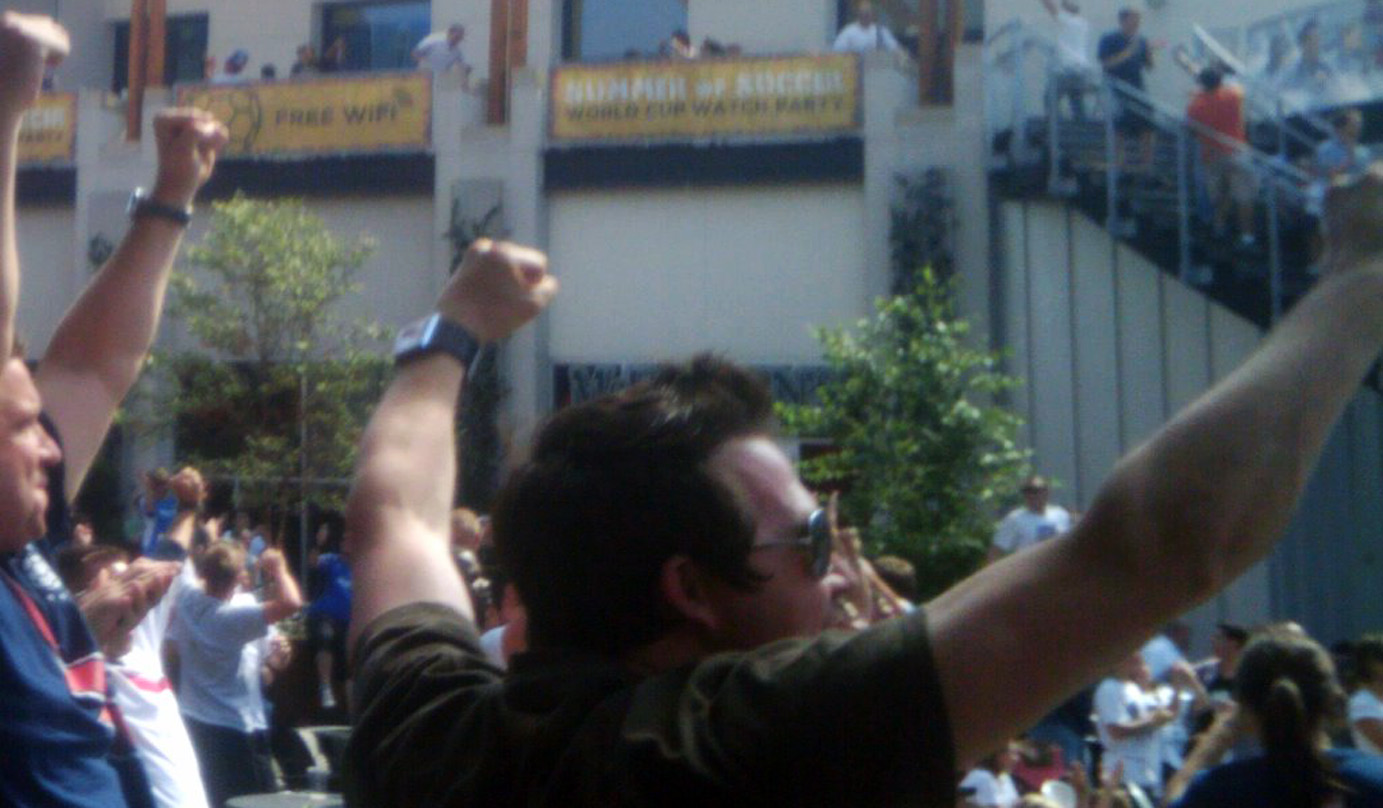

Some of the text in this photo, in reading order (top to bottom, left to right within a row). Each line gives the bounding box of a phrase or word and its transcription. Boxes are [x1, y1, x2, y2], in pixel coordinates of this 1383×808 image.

[566, 76, 686, 104] SUMMER
[736, 68, 845, 98] SOCCER
[275, 106, 335, 127] FREE
[566, 93, 846, 121] WORLD CUP WATCH PARTY
